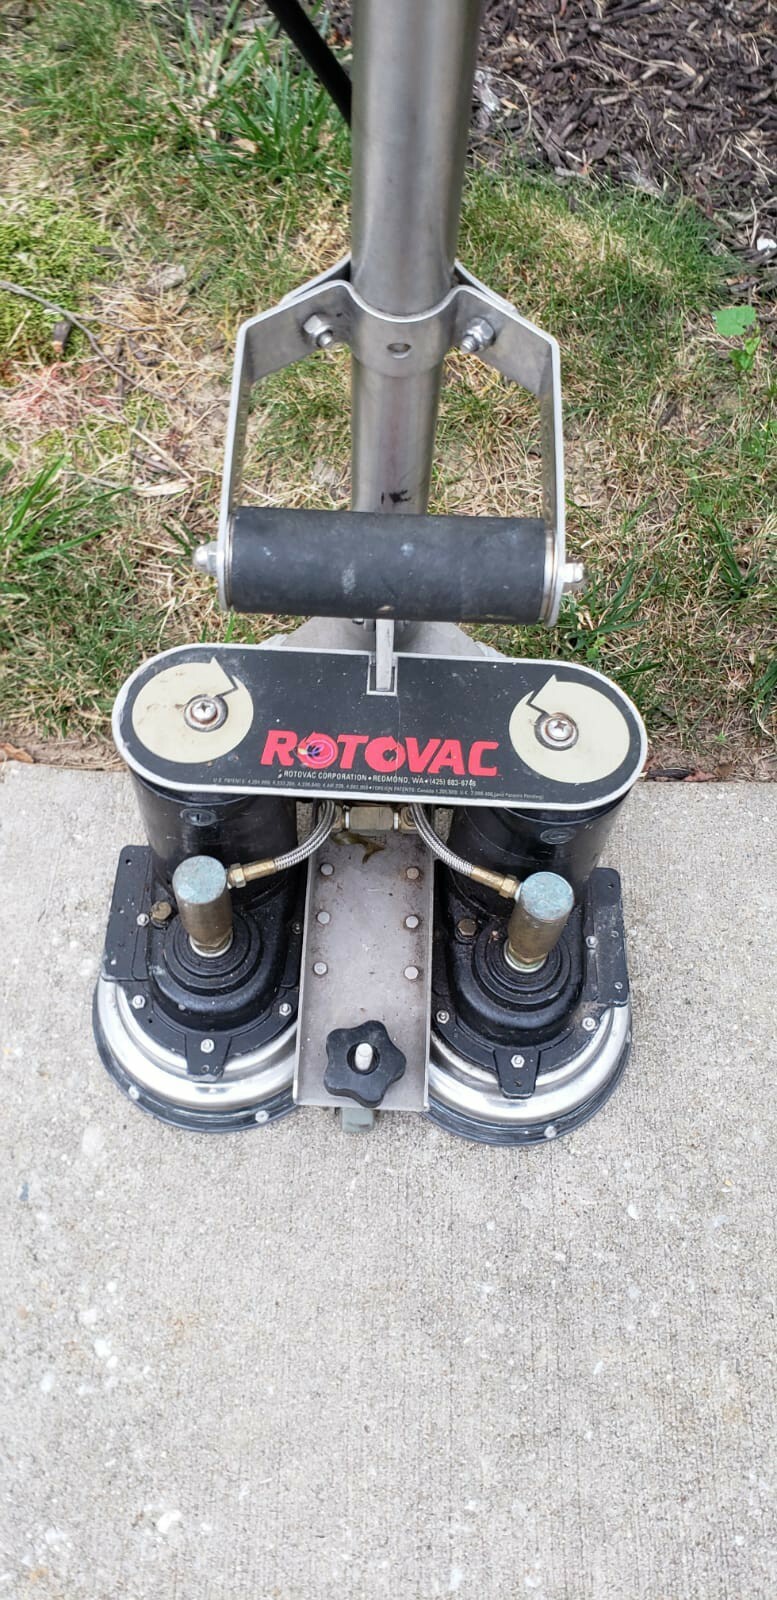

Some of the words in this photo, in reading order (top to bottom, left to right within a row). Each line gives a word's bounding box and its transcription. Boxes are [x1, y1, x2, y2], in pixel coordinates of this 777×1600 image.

[260, 730, 500, 776] ROTOVAC
[284, 769, 316, 778] ROTOVAC
[318, 771, 367, 781] CORPORATION
[412, 776, 424, 784] WA
[429, 778, 446, 786] (425)
